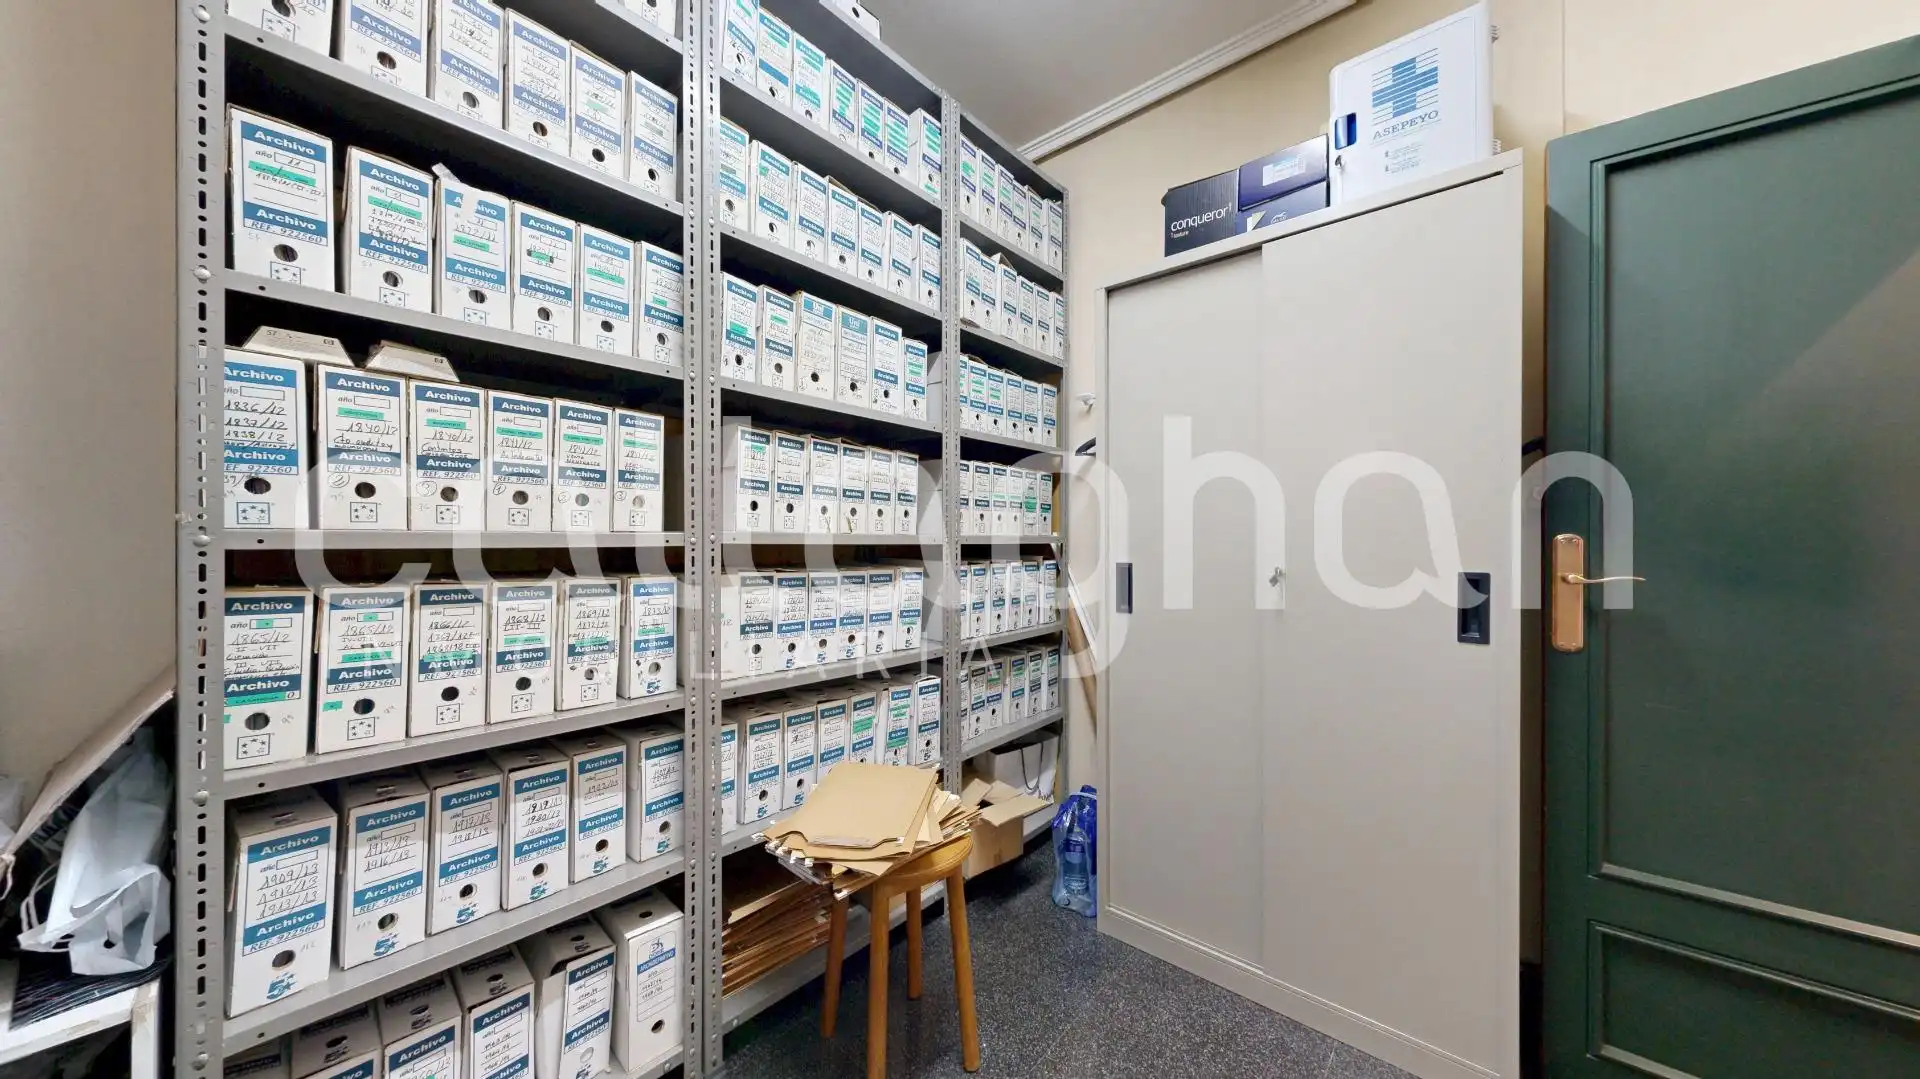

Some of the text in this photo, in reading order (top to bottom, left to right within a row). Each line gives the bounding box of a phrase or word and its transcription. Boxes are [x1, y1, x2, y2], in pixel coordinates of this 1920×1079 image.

[459, 0, 492, 21] chivo
[362, 14, 412, 45] Archivo
[522, 31, 559, 53] Archivo
[451, 57, 491, 84] Archivo
[522, 91, 559, 114] Archivo
[1373, 111, 1438, 139] ASEPEYO
[255, 131, 315, 156] Archivo
[371, 168, 419, 191] Archivo
[454, 196, 497, 216] Aivo
[257, 209, 317, 230] Archivo
[1171, 206, 1228, 231] conqueror
[250, 221, 323, 243] REF. 922560
[529, 219, 566, 236] Archivo
[370, 239, 419, 259] Archivo
[591, 239, 624, 255] Archivo
[455, 263, 498, 280] Archivo
[652, 256, 680, 271] Archivo
[528, 279, 566, 296] Archivo
[590, 296, 623, 311] Archivo
[651, 309, 679, 323] Archivo
[224, 367, 284, 381] Archivo
[337, 378, 390, 392] Archivo
[425, 390, 471, 403] Archivo
[502, 402, 541, 414] Archivo
[567, 410, 601, 422] Archivo
[625, 417, 655, 427] Archivo
[224, 449, 286, 461] Archivo
[339, 452, 391, 463] Archivo
[427, 459, 472, 468] Archivo
[501, 464, 541, 474] Archivo
[566, 470, 600, 479] Archivo
[624, 473, 654, 481] Archivo
[341, 597, 393, 605] Archivo
[430, 593, 475, 602] Archivo
[506, 589, 545, 598] Archivo
[231, 602, 293, 611] Archivo
[429, 659, 473, 668] Archivo
[505, 651, 544, 660] Archivo
[339, 668, 392, 679] Archivo
[227, 680, 290, 692] Archivo
[650, 743, 679, 757] Archivo
[585, 757, 618, 769] Archivo
[522, 775, 560, 790] Archivo
[450, 789, 492, 805] Archivo
[651, 798, 679, 810] Archivo
[367, 810, 416, 827] Archivo
[586, 813, 618, 827] Archivo
[260, 834, 320, 856] Archivo
[522, 835, 559, 851] Archivo
[448, 854, 491, 872] Archivo
[365, 879, 413, 900] Archivo
[257, 913, 314, 936] Archivo
[250, 923, 319, 951] REF. 922560
[575, 958, 609, 979] Archivo
[482, 1002, 522, 1025] Archivo
[571, 1016, 604, 1039] Archivo
[399, 1036, 446, 1061] Archivo
